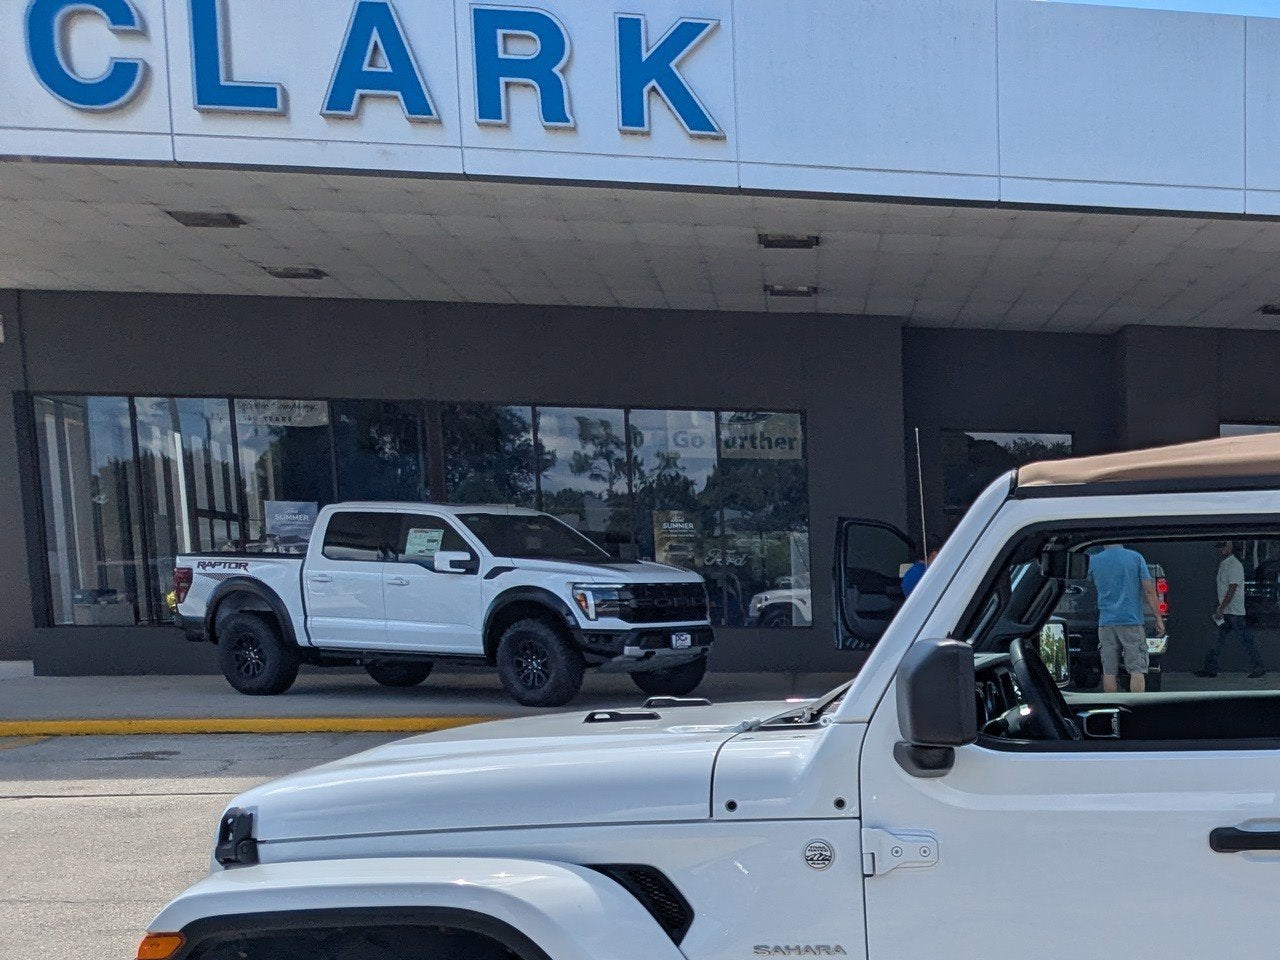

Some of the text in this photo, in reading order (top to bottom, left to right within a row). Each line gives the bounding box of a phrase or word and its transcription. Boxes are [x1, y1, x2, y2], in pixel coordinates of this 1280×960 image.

[23, 0, 726, 140] CLARK
[671, 430, 706, 449] Go
[273, 513, 310, 522] SUMMER
[662, 522, 695, 530] SUMMER
[196, 560, 250, 573] RAPTOR
[752, 944, 848, 957] SAHARA
